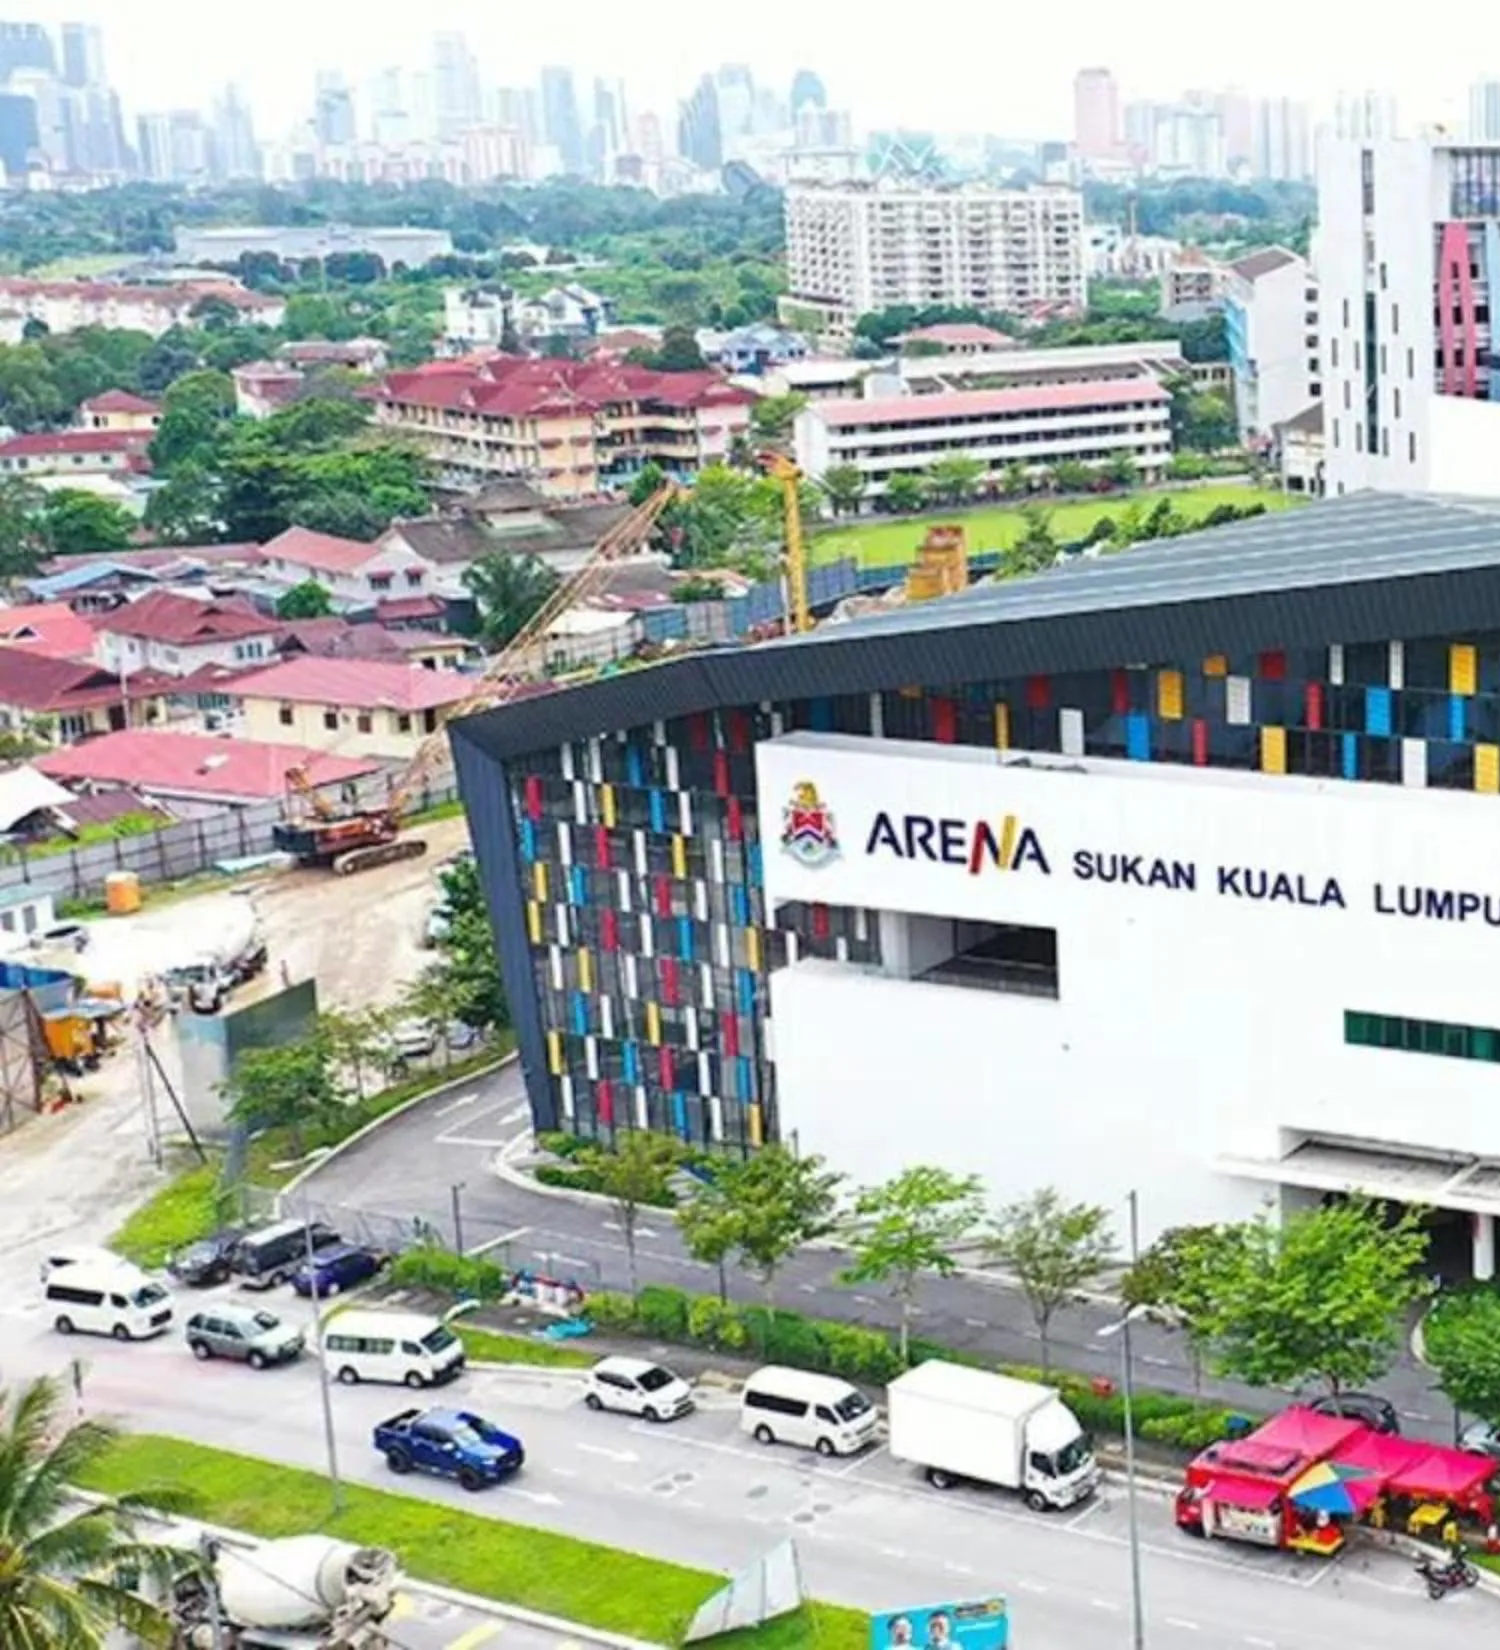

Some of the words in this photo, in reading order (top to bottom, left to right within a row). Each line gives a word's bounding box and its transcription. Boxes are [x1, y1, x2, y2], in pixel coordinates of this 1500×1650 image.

[866, 811, 1051, 875] ARENA
[1073, 850, 1196, 891] SUKAN
[1217, 866, 1347, 908] KUALA
